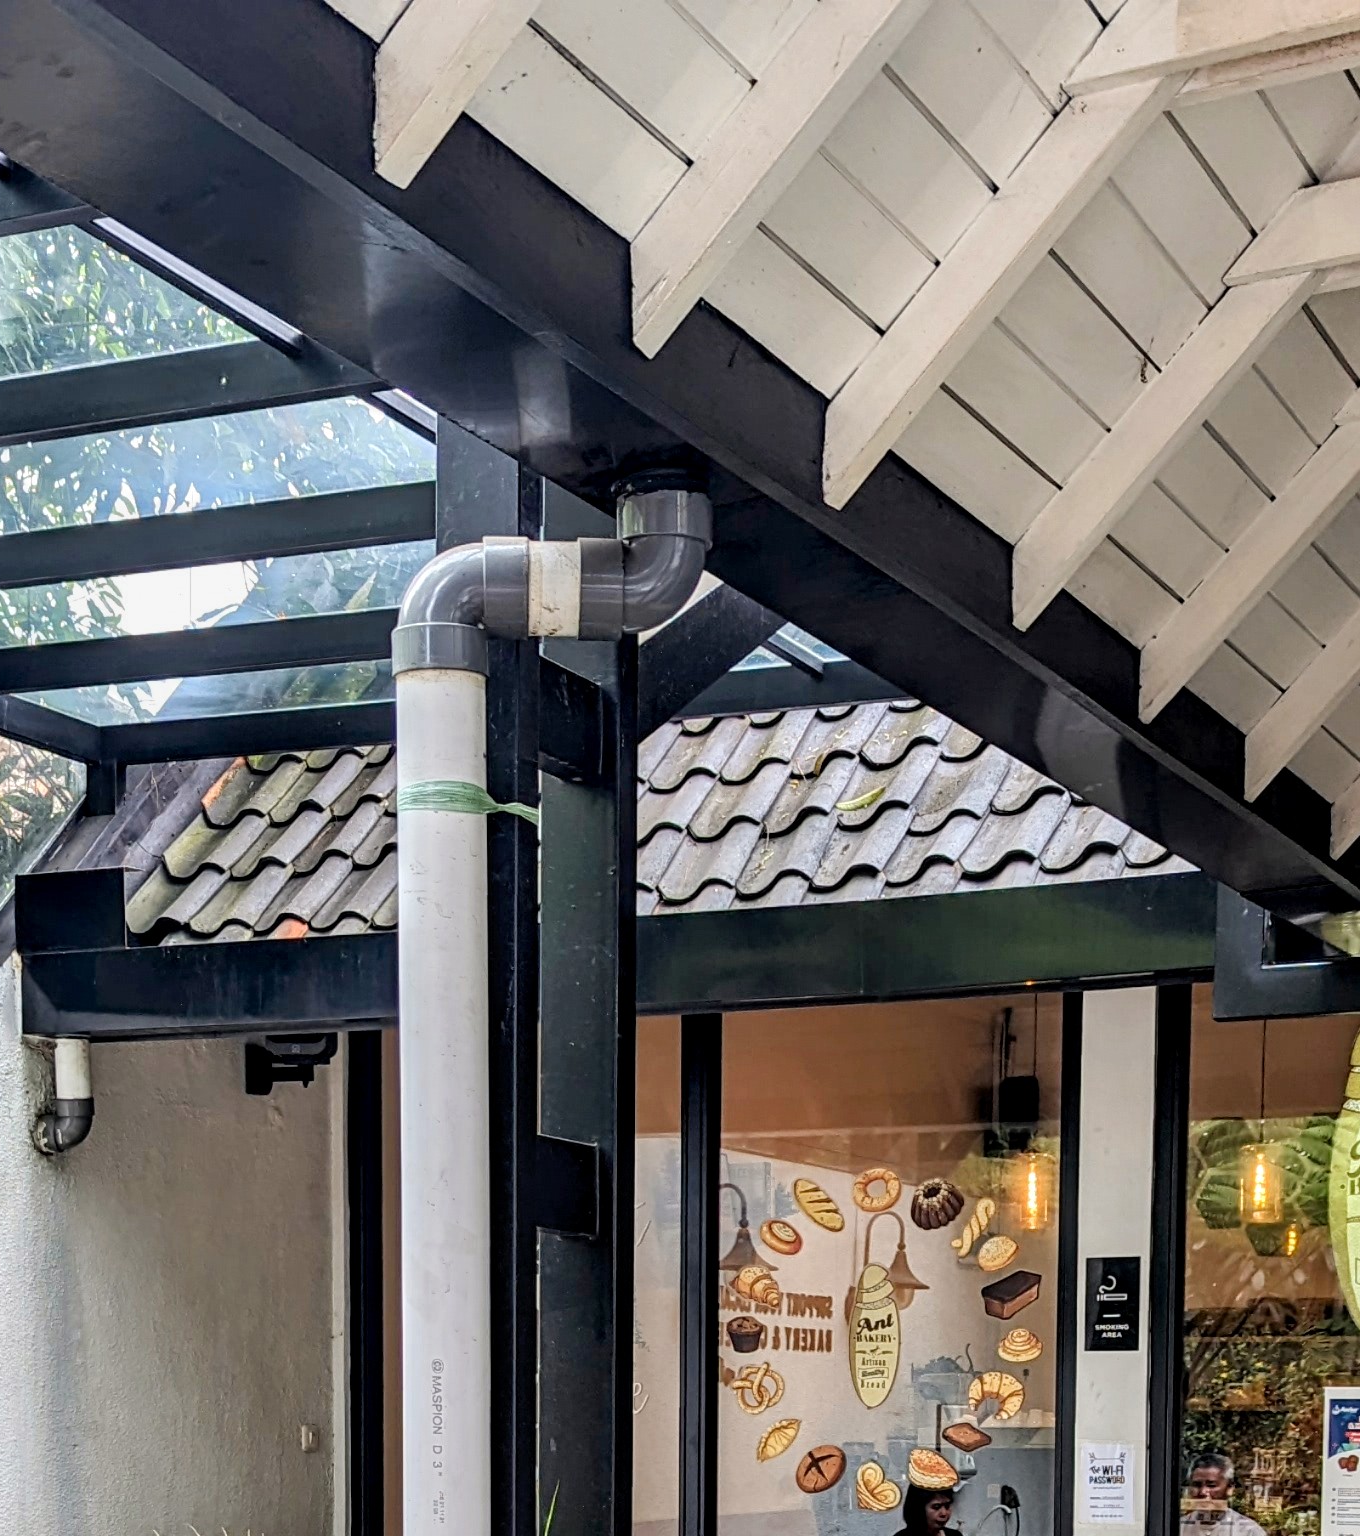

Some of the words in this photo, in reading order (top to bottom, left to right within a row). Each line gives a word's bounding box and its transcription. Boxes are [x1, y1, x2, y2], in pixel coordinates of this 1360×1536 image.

[856, 1313, 894, 1334] Ant
[856, 1333, 893, 1343] BAKERY
[432, 1375, 442, 1435] MASPION
[433, 1445, 442, 1455] D
